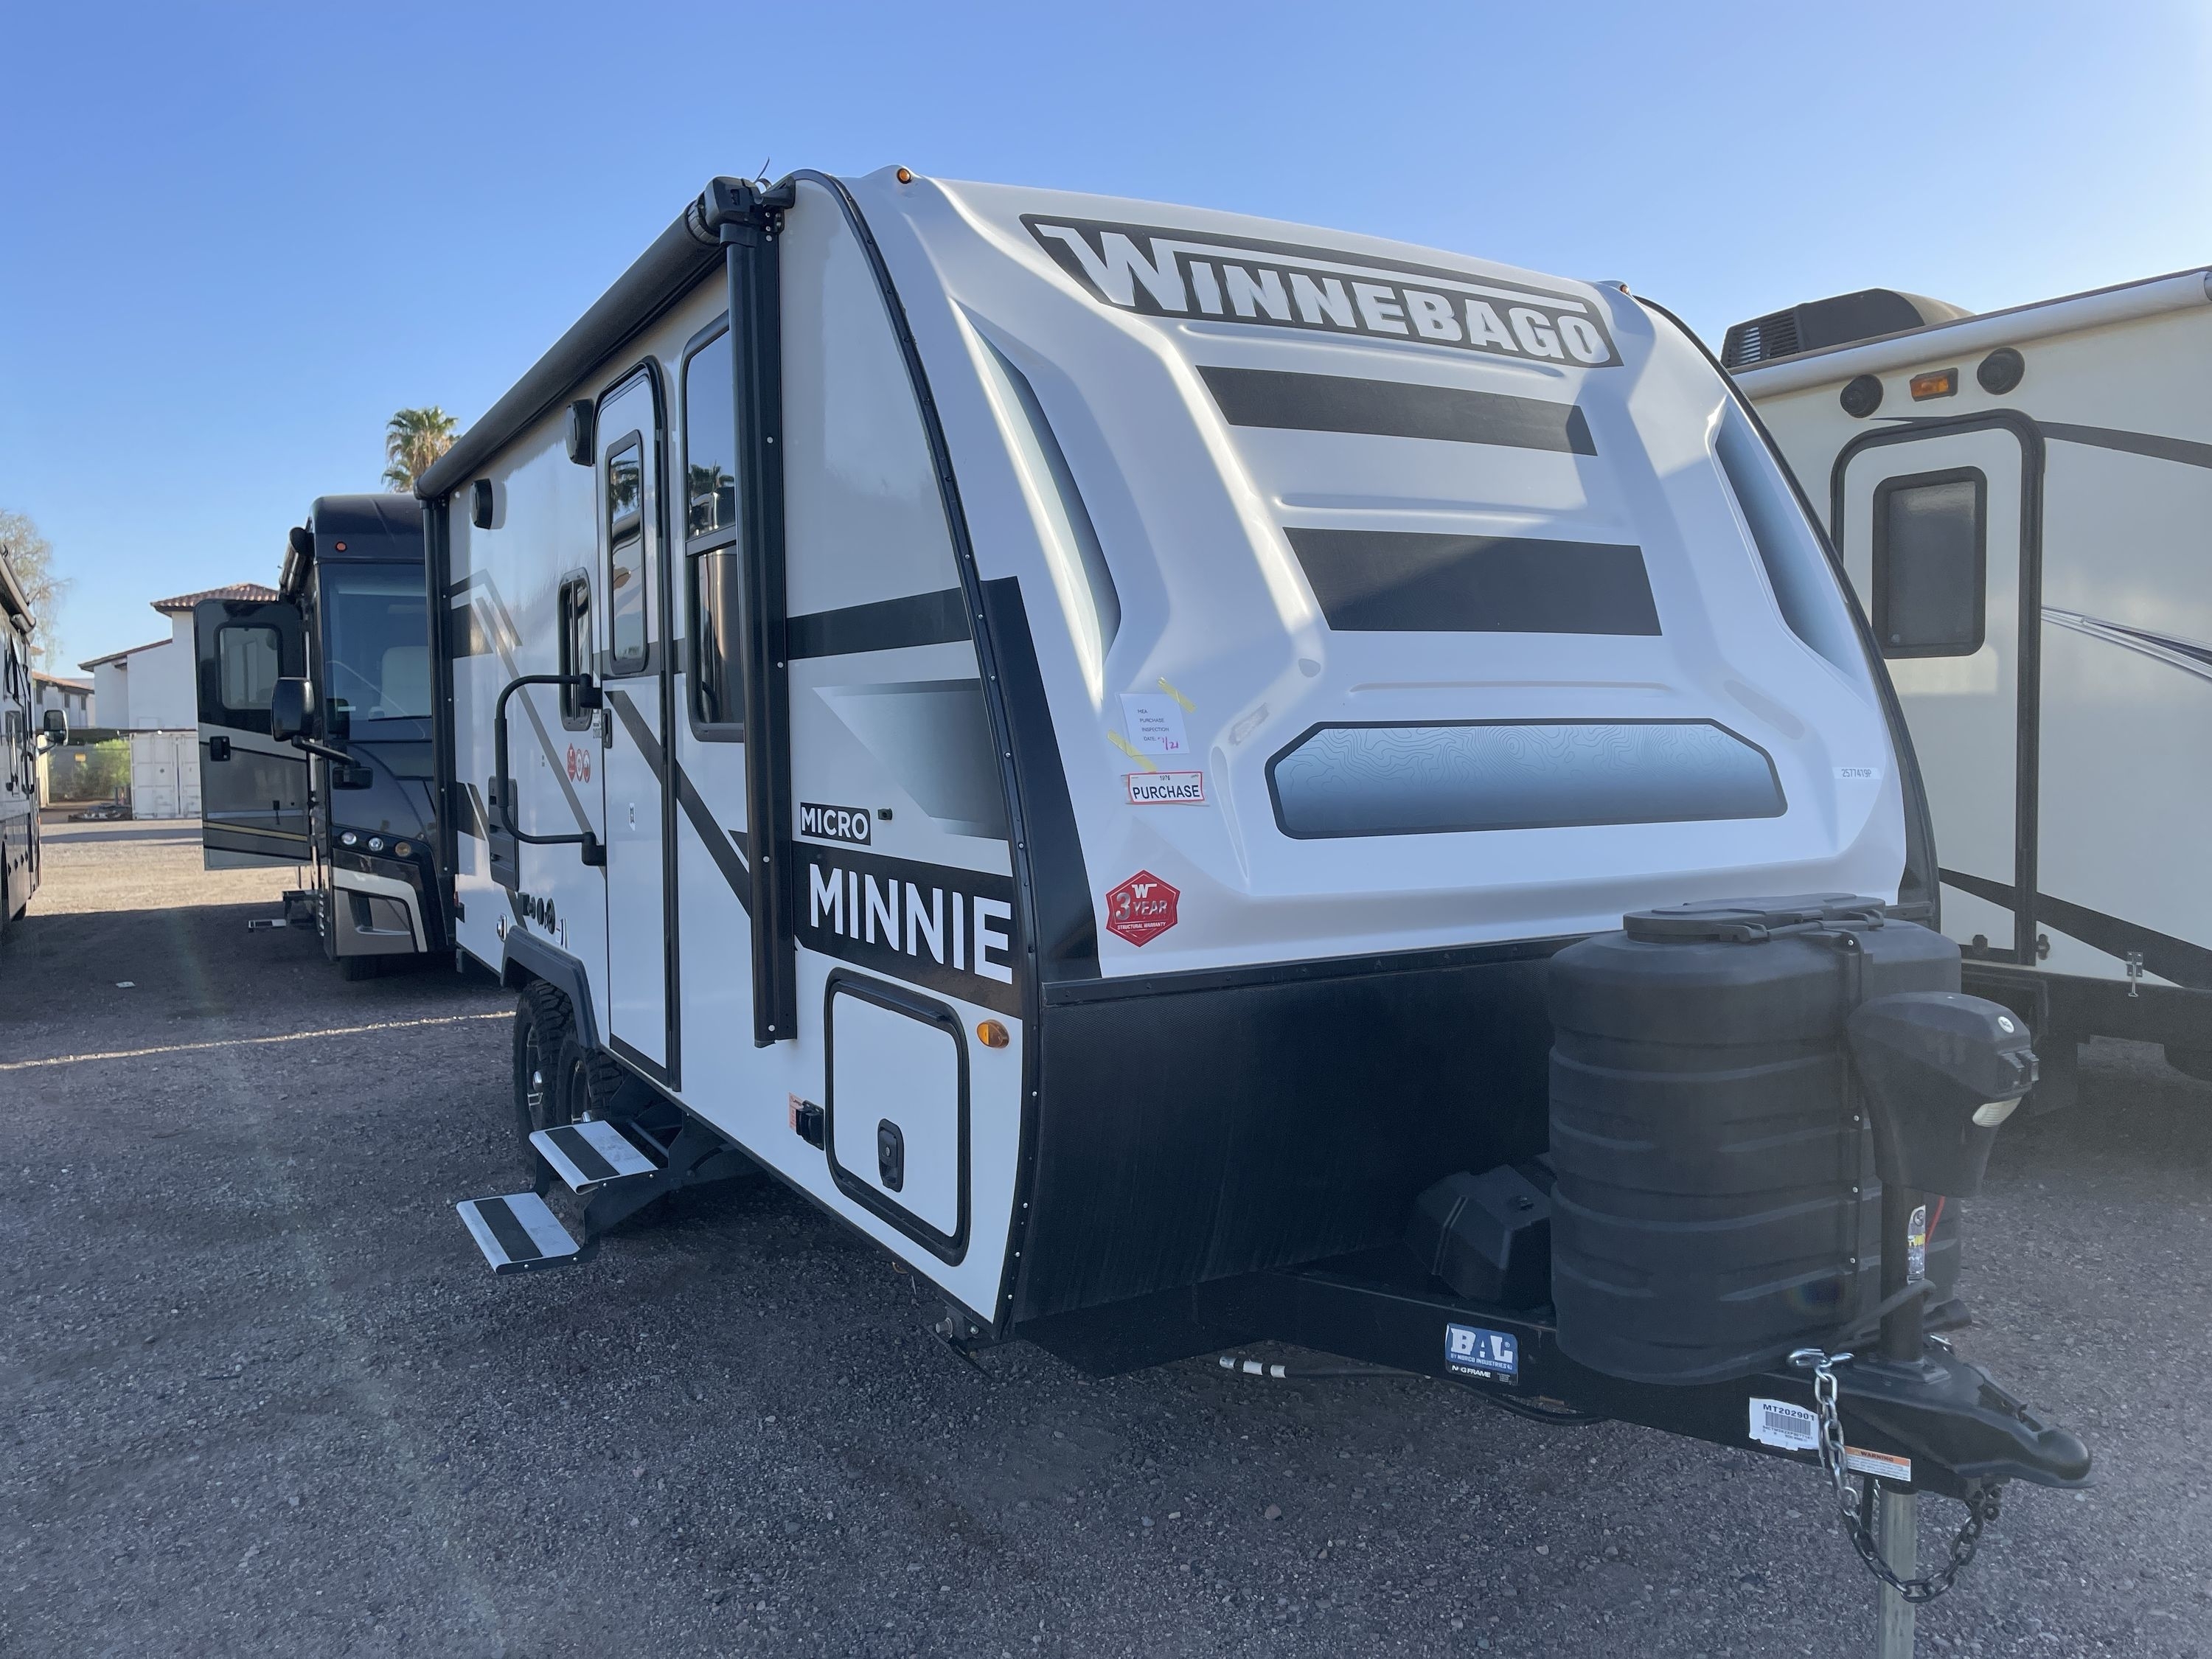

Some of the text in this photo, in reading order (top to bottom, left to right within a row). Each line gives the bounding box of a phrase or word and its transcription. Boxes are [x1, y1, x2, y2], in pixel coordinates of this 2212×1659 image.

[1034, 223, 1611, 364] WINNEBAGO
[1133, 785, 1200, 799] PURCHASE
[801, 806, 869, 840] MICRO
[1116, 892, 1168, 920] 3 YEAR
[810, 863, 1012, 985] MINNIE
[1458, 1353, 1475, 1363] NORCO
[1476, 1357, 1507, 1368] INDUSTRIES
[1763, 1403, 1815, 1421] MT202901
[1860, 1450, 1893, 1462] WARNING
